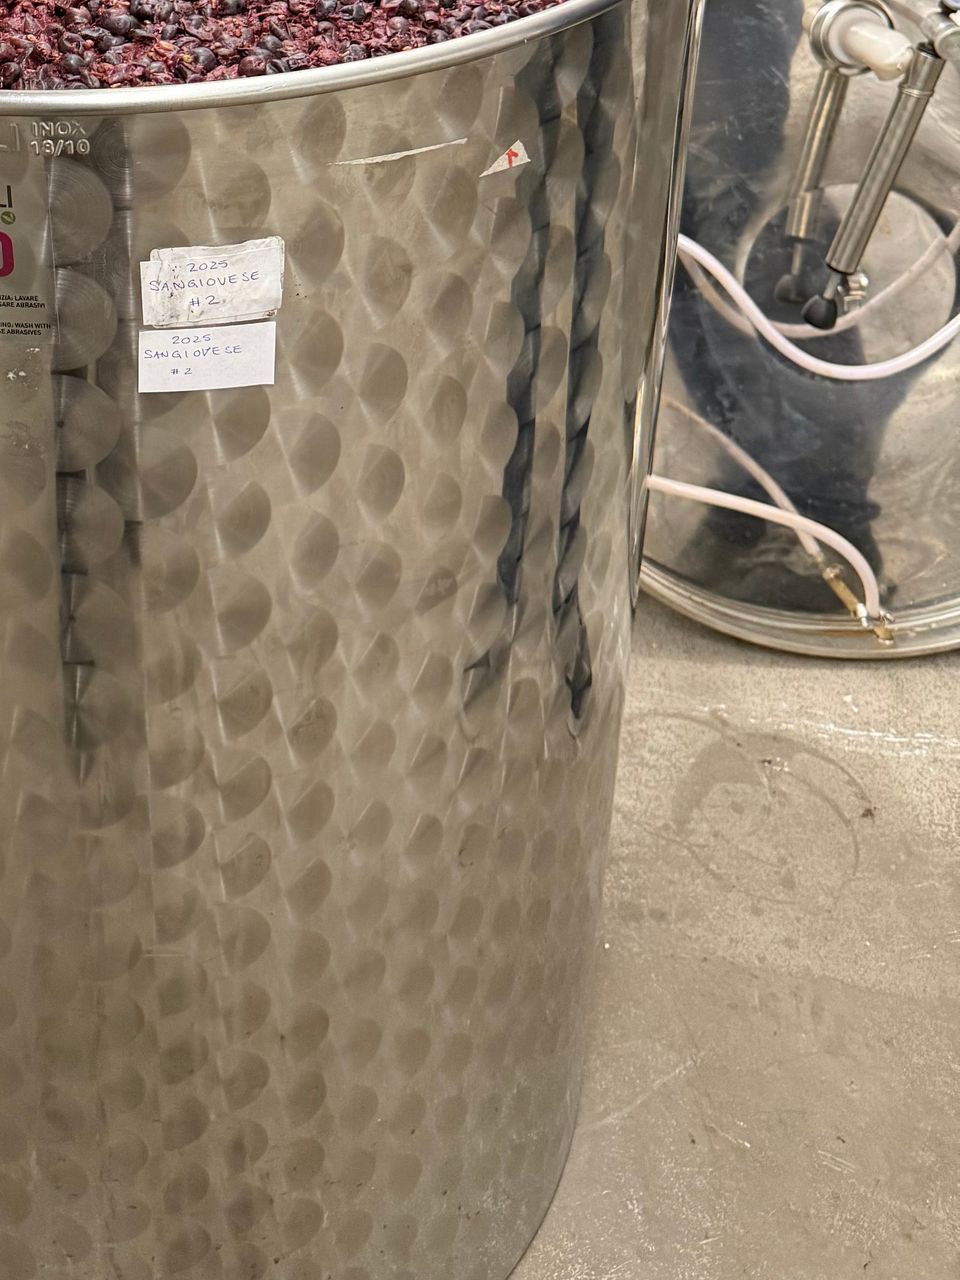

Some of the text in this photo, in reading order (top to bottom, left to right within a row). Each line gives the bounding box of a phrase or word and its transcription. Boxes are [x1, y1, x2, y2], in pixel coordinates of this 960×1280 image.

[32, 121, 87, 137] INOX
[186, 260, 229, 273] 2025
[149, 271, 260, 292] SANGIOVESE
[171, 334, 212, 345] 2025
[143, 345, 243, 360] SANGIOVESE
